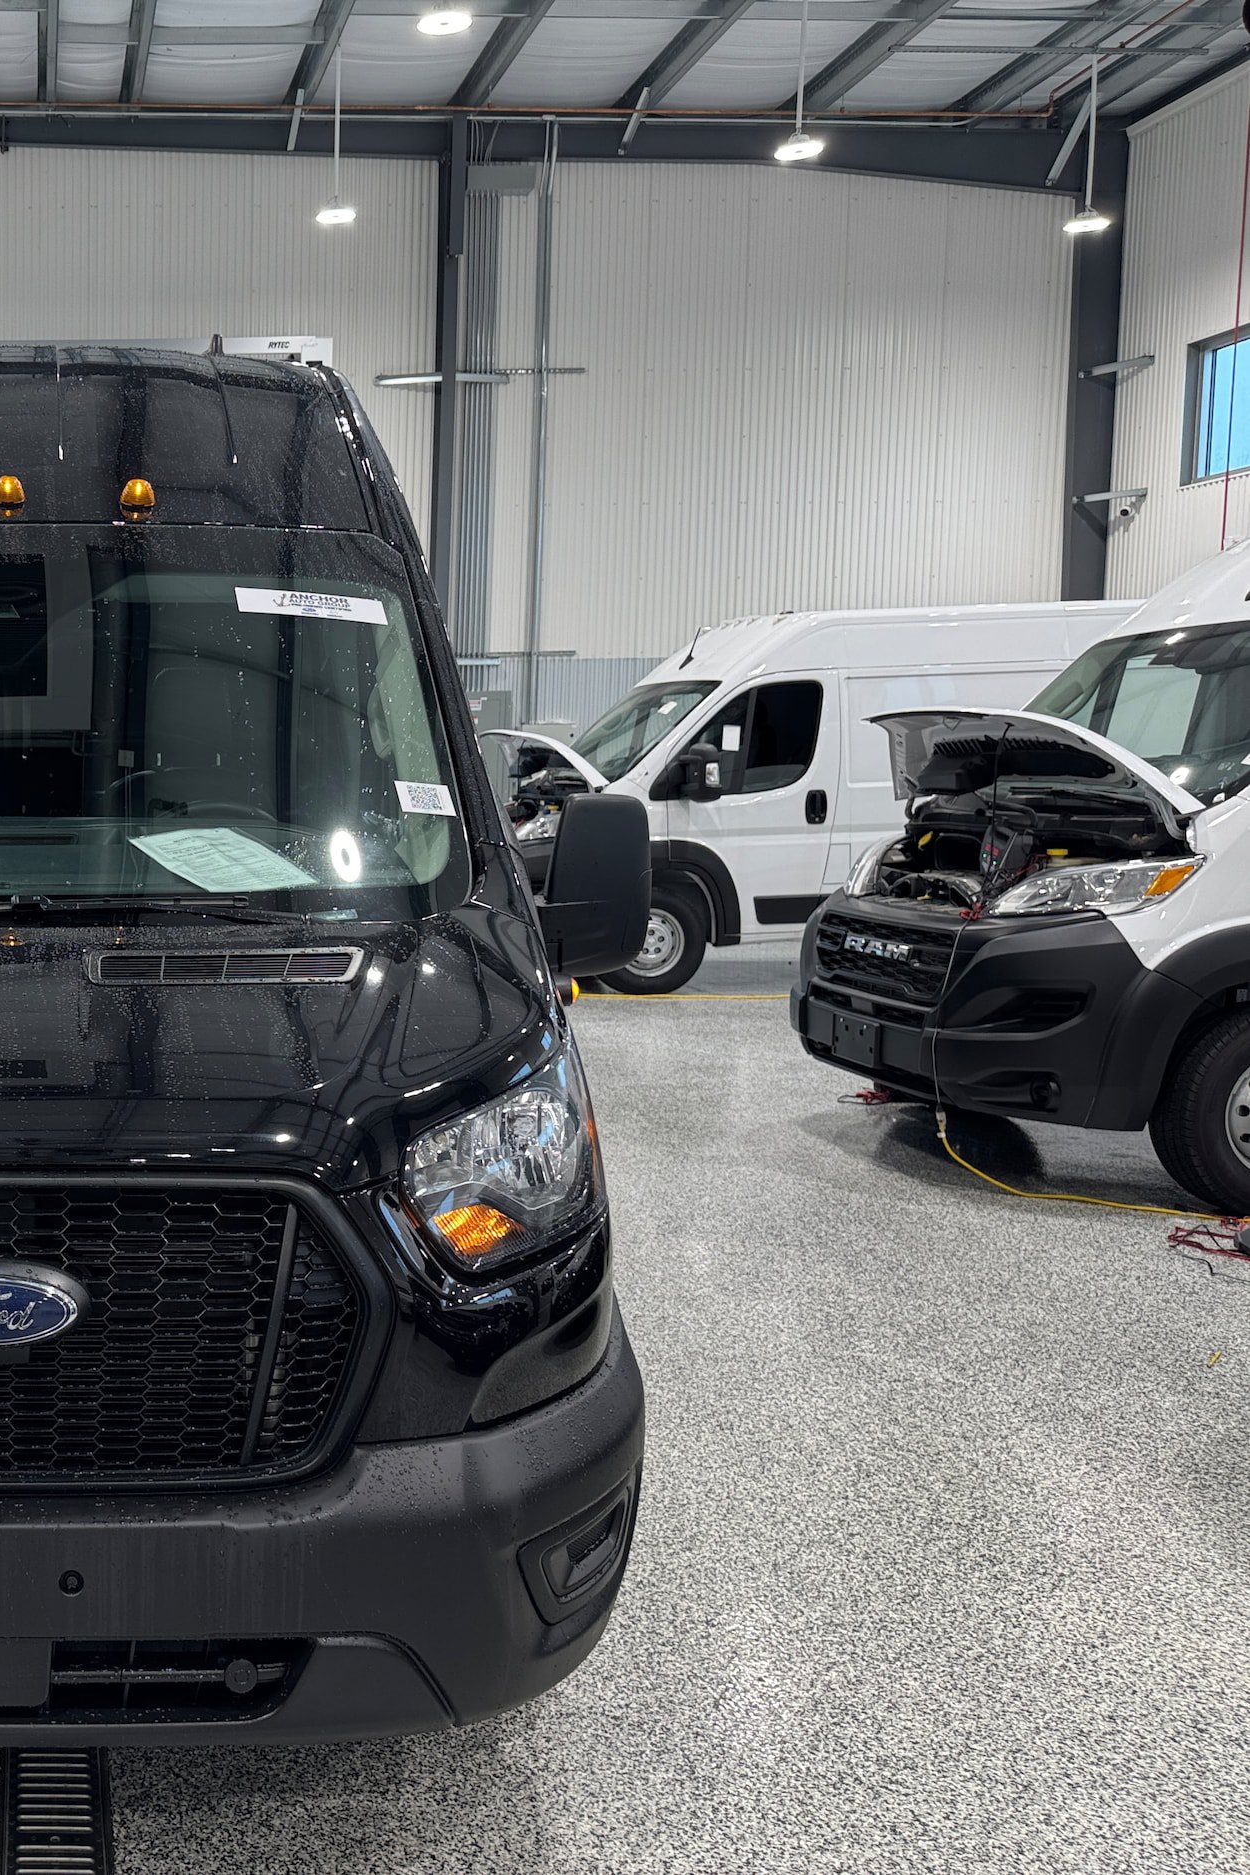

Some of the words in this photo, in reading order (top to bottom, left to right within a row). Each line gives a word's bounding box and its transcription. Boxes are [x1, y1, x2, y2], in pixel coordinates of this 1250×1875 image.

[268, 341, 290, 349] RYTEC
[290, 593, 348, 604] ANCHOR
[844, 932, 912, 961] RAM
